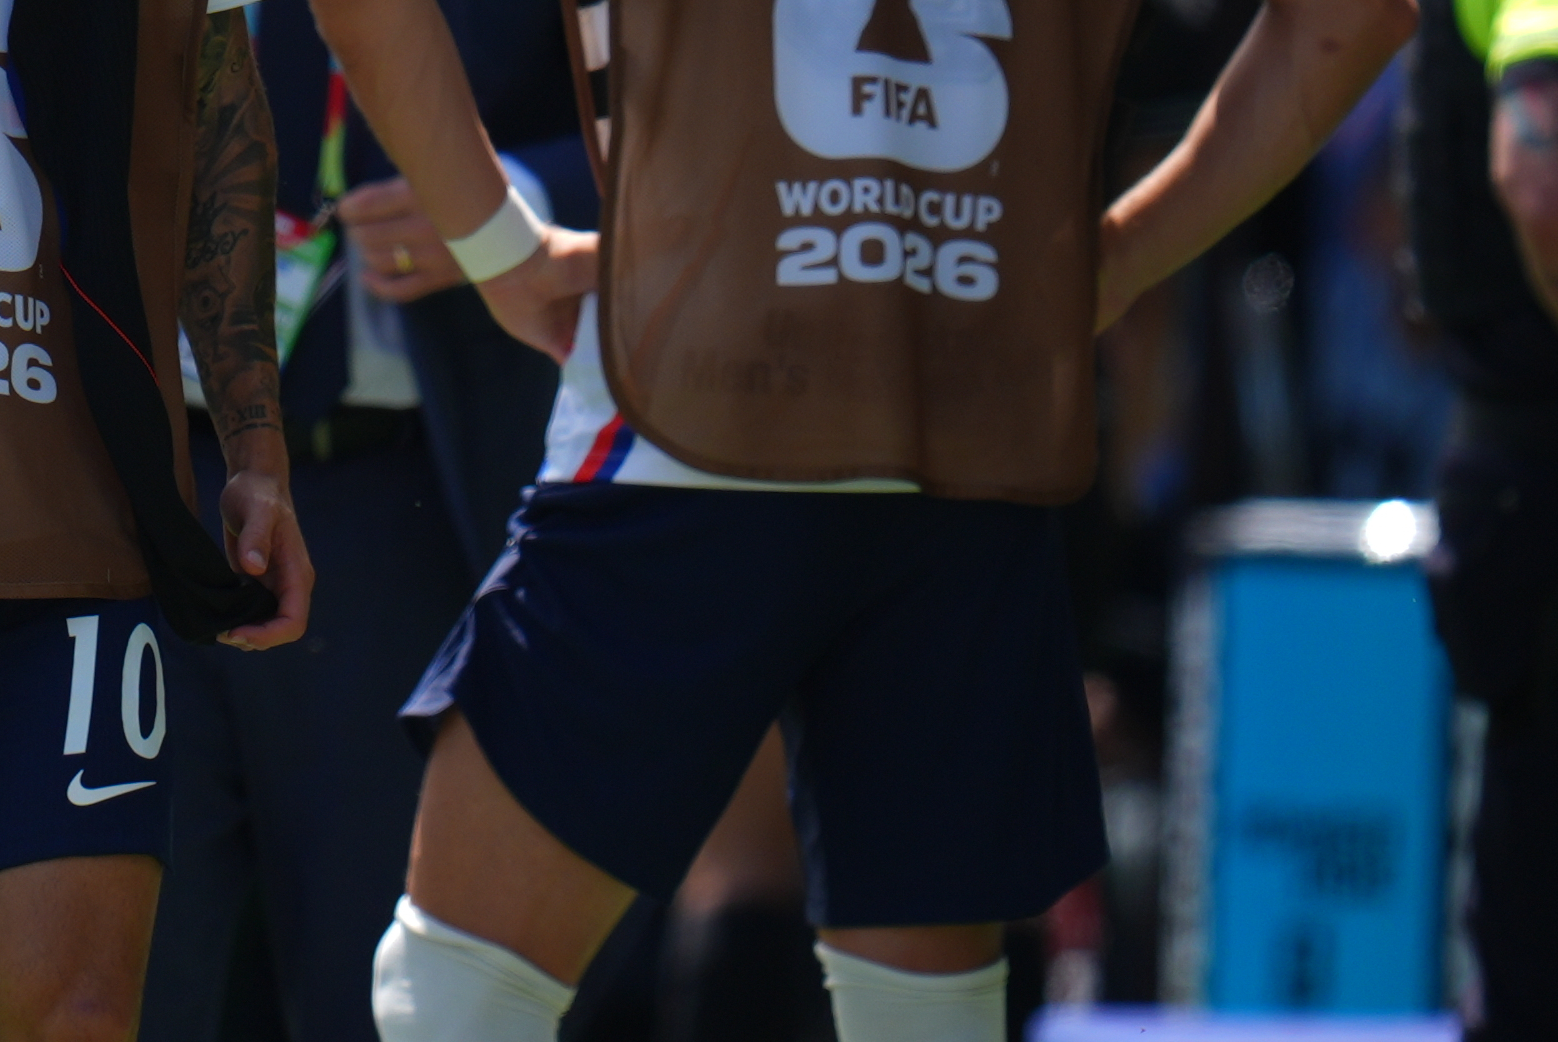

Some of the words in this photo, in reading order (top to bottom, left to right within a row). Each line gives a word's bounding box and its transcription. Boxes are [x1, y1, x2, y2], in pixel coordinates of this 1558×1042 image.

[850, 74, 940, 131] FIFA
[775, 176, 915, 221] WORLD
[918, 189, 1004, 234] CUP
[775, 220, 1000, 303] 2026
[62, 614, 168, 760] 10
